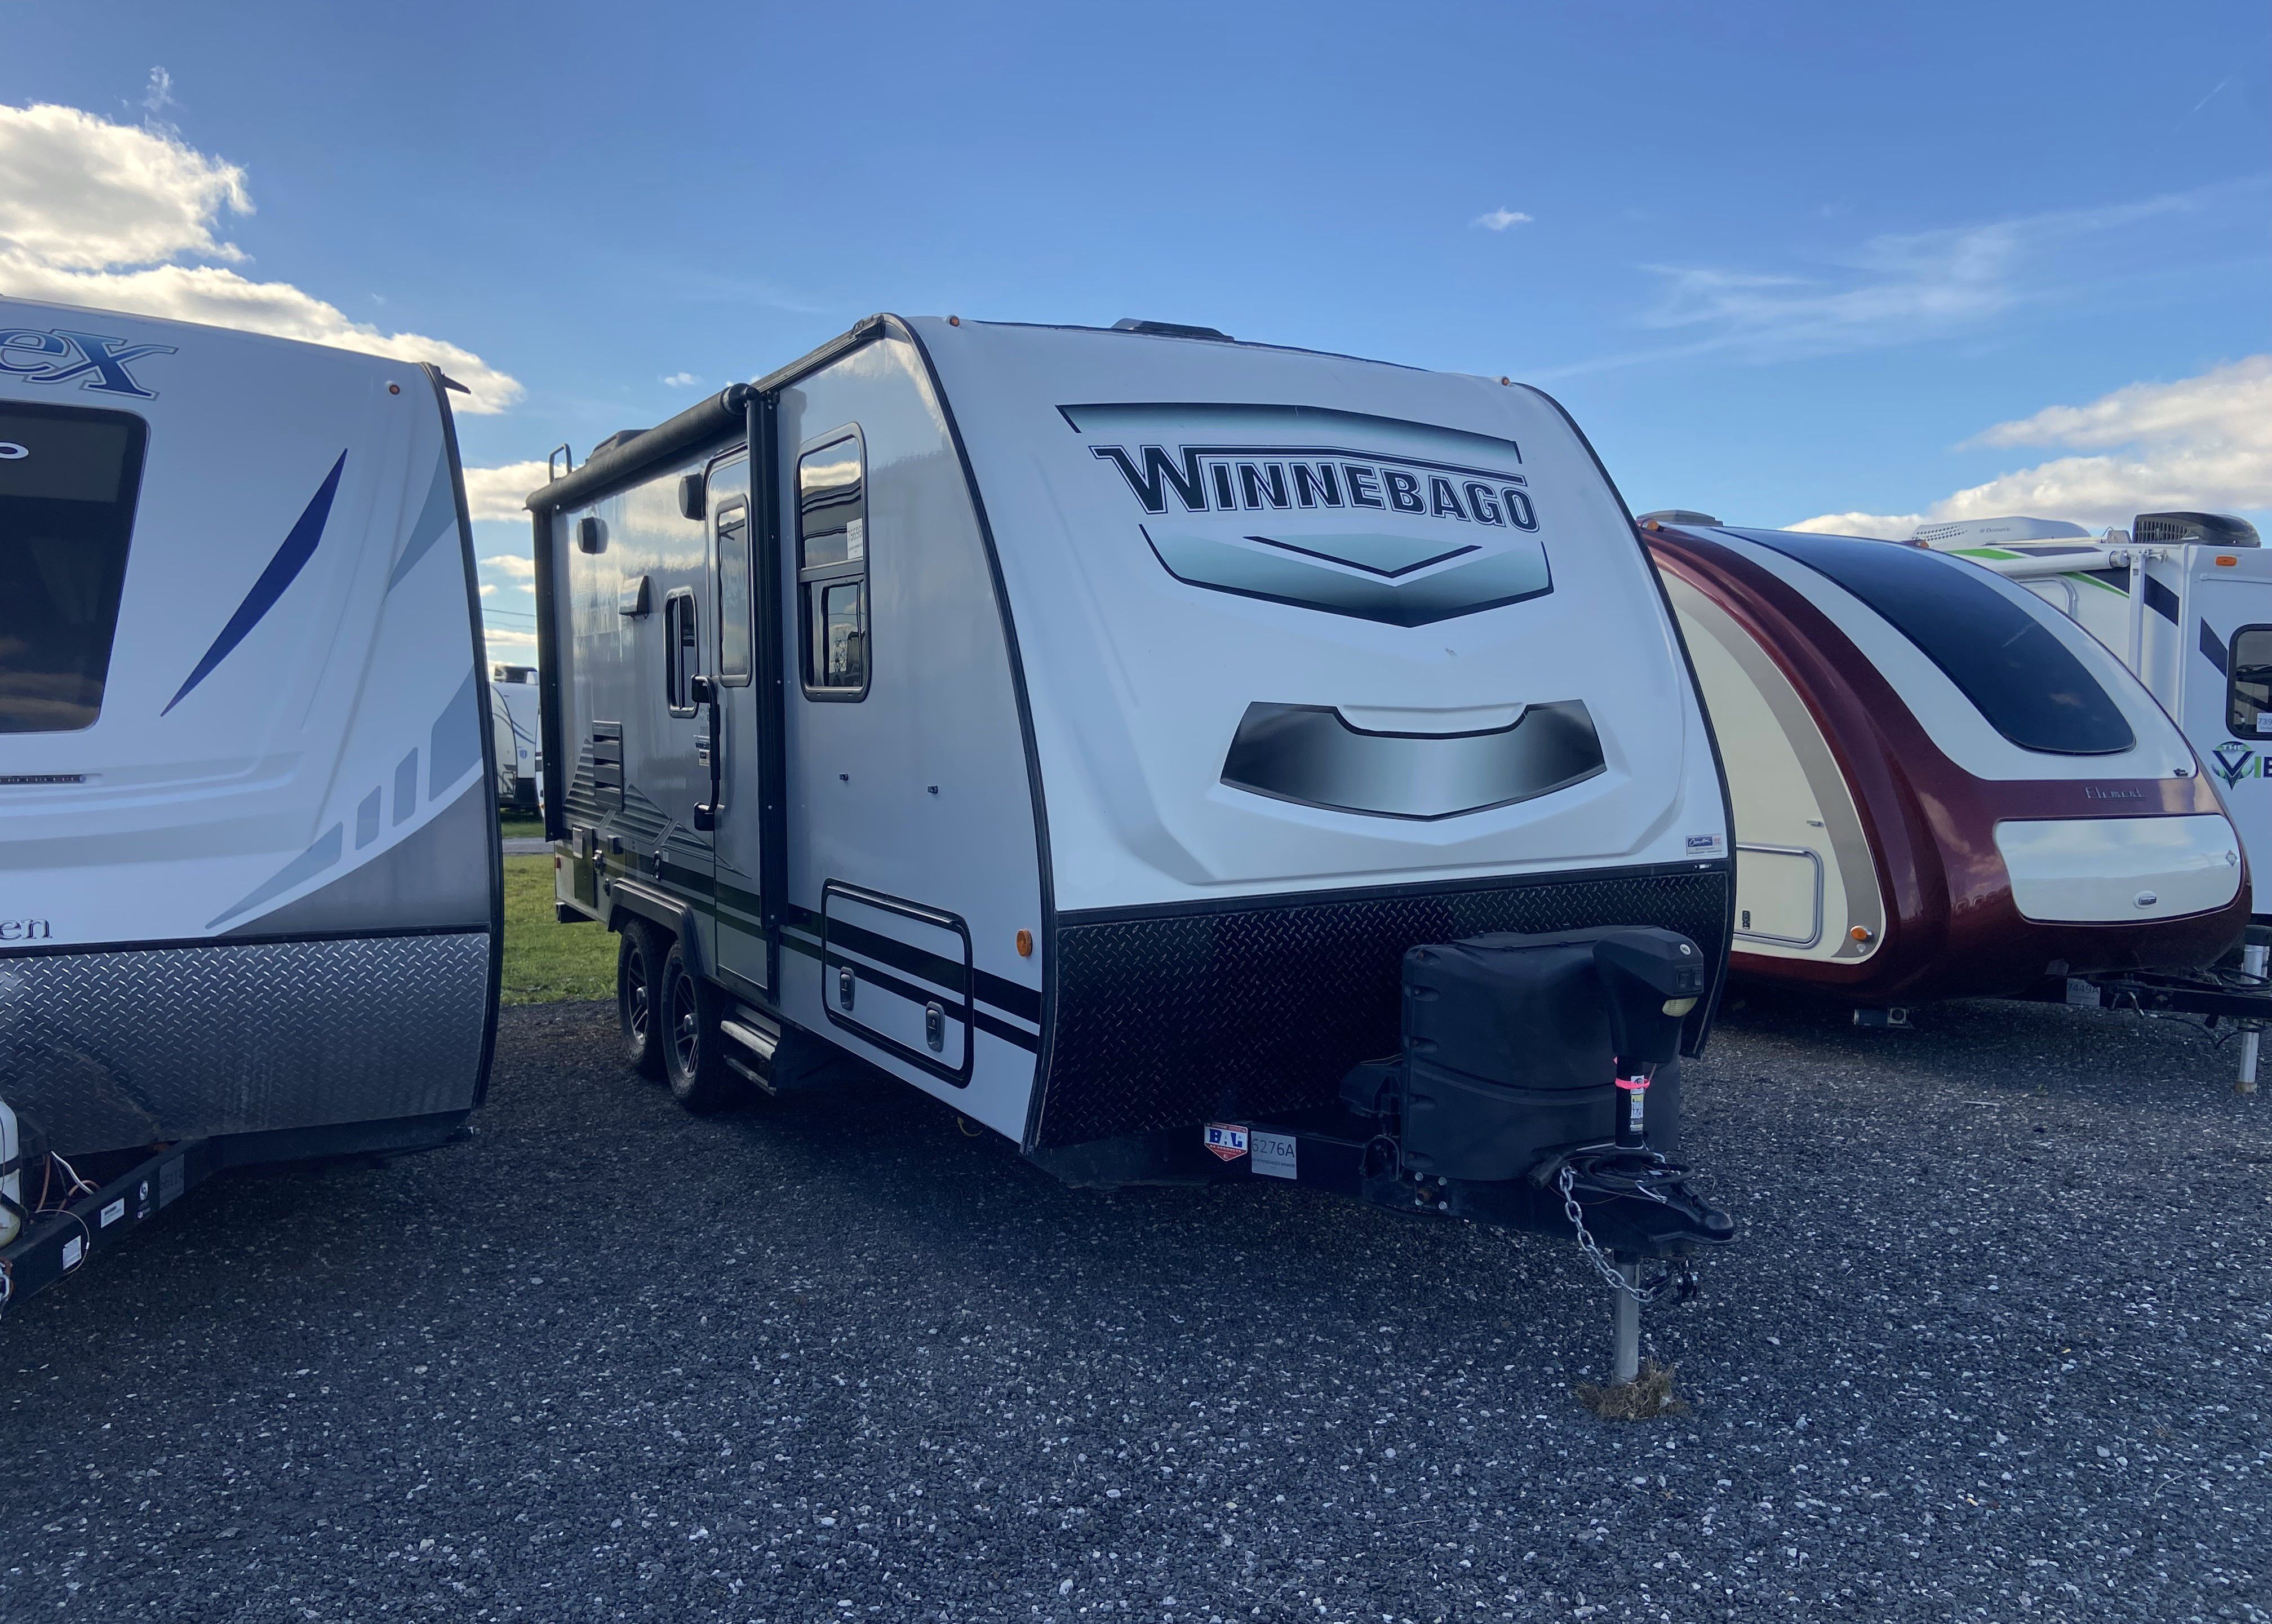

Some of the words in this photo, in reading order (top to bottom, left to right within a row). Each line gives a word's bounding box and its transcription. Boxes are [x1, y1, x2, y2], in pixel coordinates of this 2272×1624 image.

[1088, 444, 1540, 533] WINNEBAGO
[1209, 1129, 1242, 1147] BAL
[1252, 1138, 1295, 1158] 6276A
